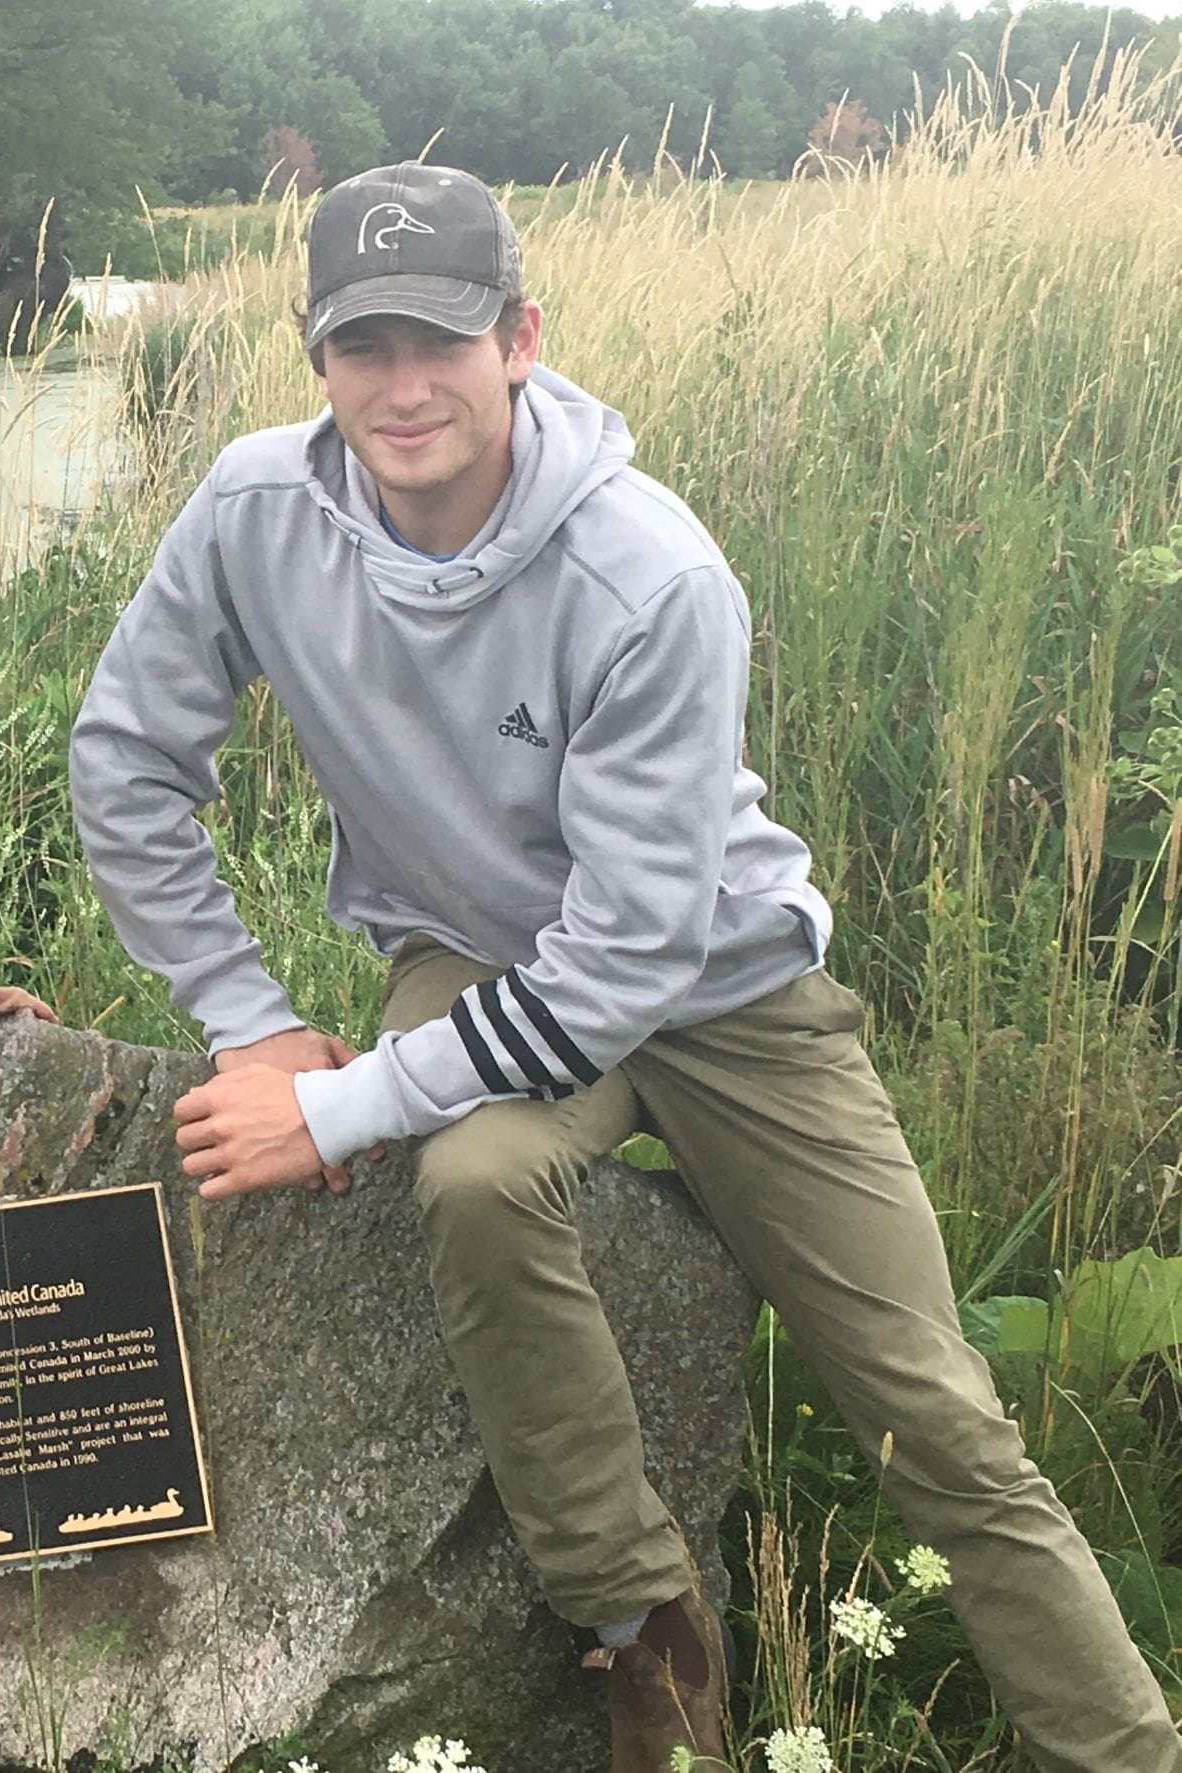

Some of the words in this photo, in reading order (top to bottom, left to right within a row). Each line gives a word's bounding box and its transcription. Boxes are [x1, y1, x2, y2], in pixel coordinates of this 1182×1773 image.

[498, 724, 549, 749] adidas
[31, 1279, 84, 1301] Canada
[15, 1303, 61, 1318] Wetlands
[62, 1338, 90, 1349] South
[94, 1334, 103, 1344] of
[29, 1356, 67, 1369] Canada
[70, 1354, 80, 1363] in
[83, 1349, 115, 1361] March
[118, 1344, 141, 1356] 2000
[144, 1344, 155, 1353] by
[25, 1376, 36, 1384] in
[39, 1373, 54, 1383] the
[58, 1369, 83, 1382] spirit
[86, 1366, 95, 1376] of
[99, 1363, 126, 1374] Great
[129, 1359, 158, 1370] Lakes
[37, 1413, 56, 1424] and
[81, 1407, 100, 1417] feet
[104, 1404, 114, 1414] of
[119, 1399, 164, 1412] shoreline
[25, 1428, 68, 1441] Sensitive
[73, 1423, 91, 1434] and
[95, 1422, 110, 1431] are
[114, 1420, 126, 1428] an
[129, 1412, 167, 1426] integral
[81, 1435, 116, 1450] project
[123, 1432, 142, 1442] that
[149, 1429, 169, 1437] was
[19, 1460, 57, 1473] Canada
[60, 1458, 70, 1466] in
